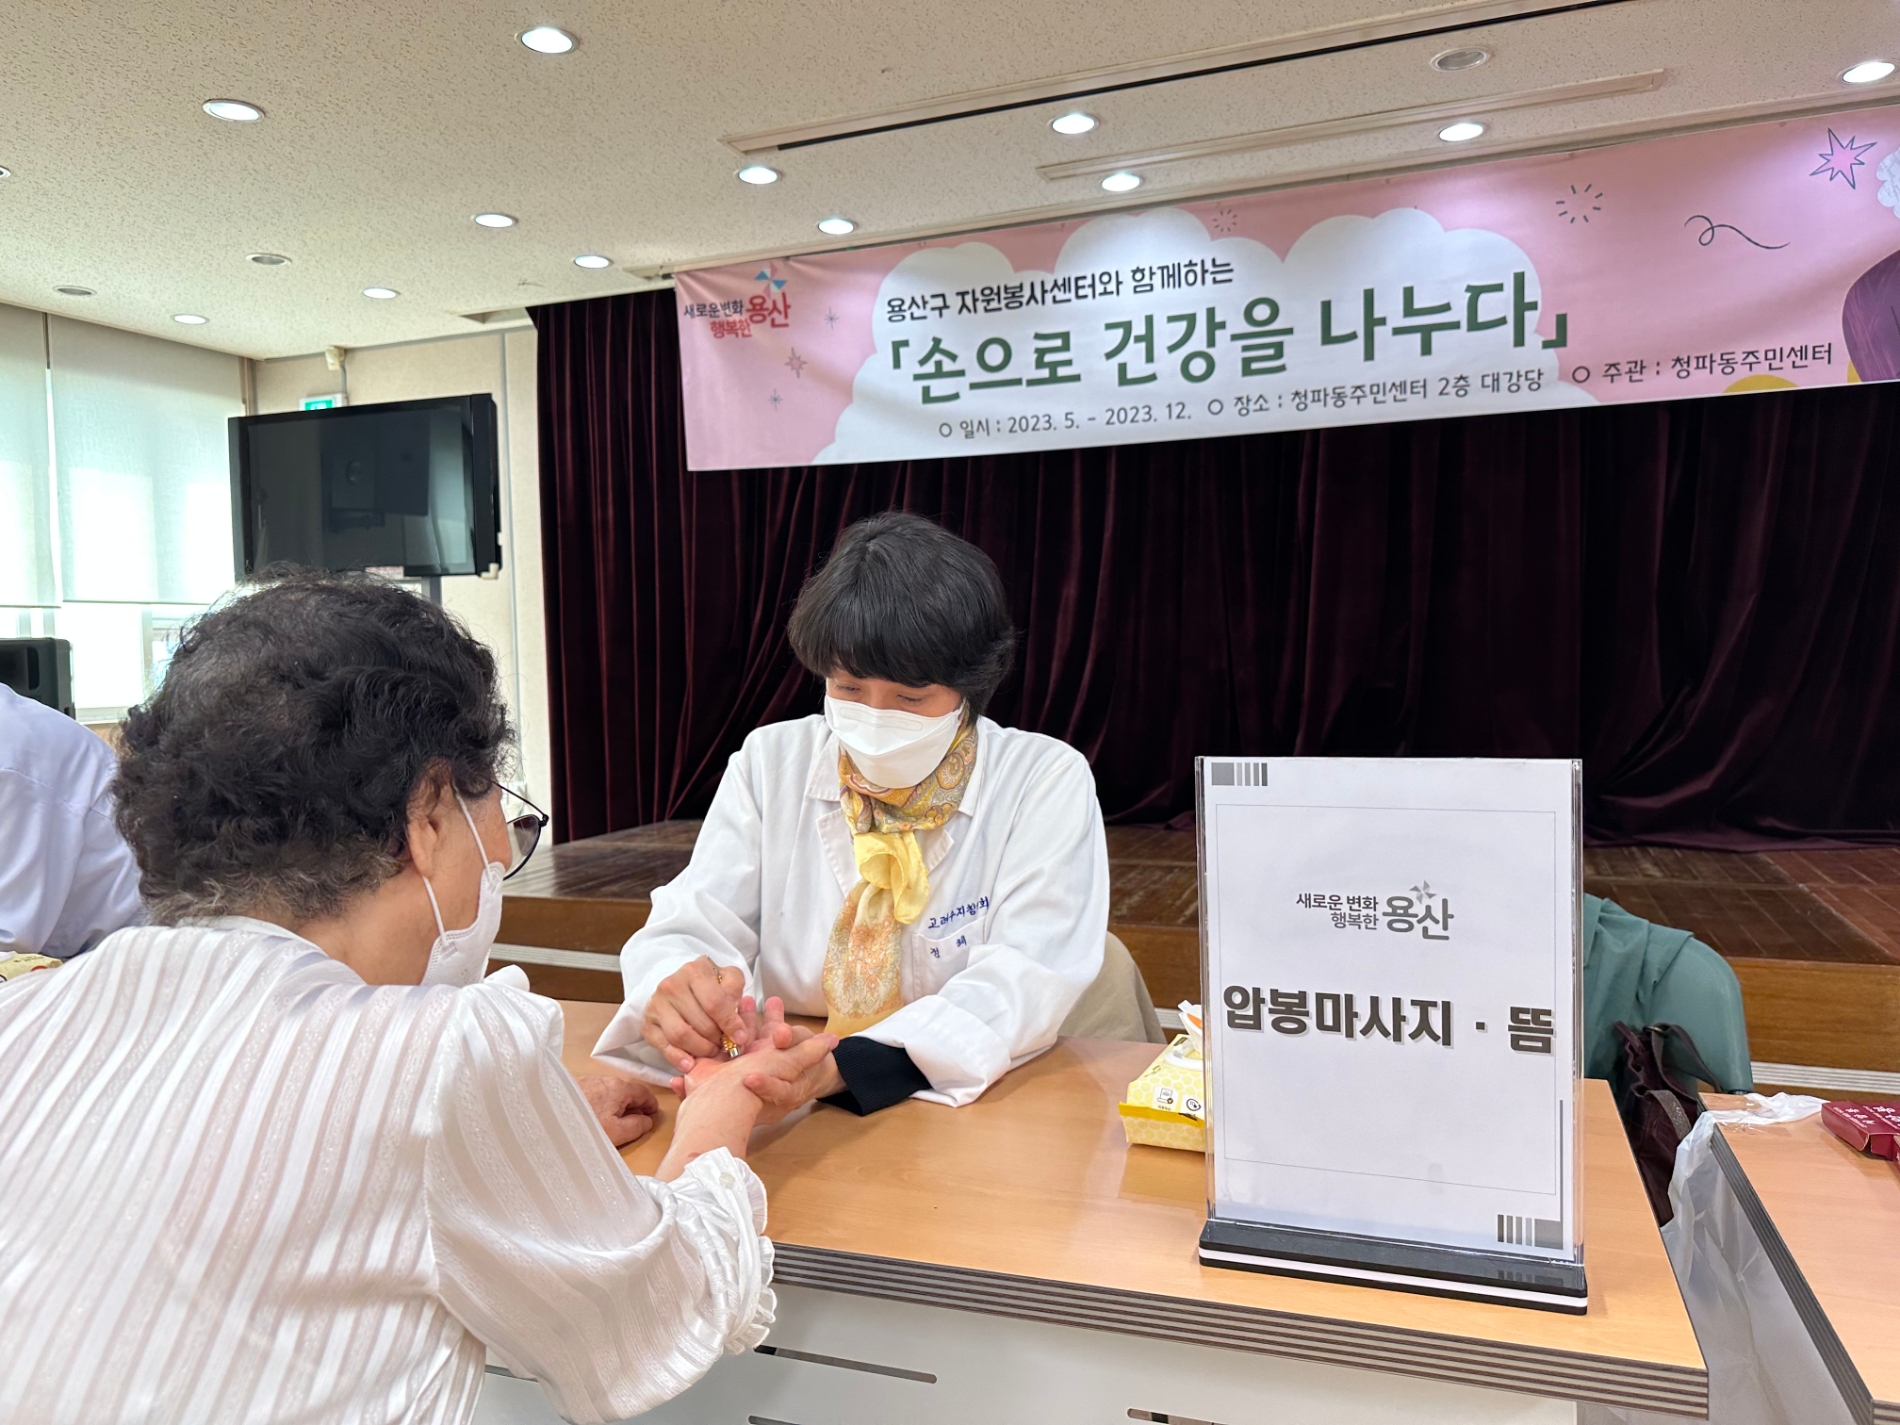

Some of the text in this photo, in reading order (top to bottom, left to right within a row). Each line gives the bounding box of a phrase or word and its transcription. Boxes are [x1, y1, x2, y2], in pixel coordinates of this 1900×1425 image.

[746, 292, 791, 329] 용산
[887, 258, 1234, 323] 용산구 자원봉사센터와 함께하는
[709, 319, 752, 339] 행복한
[1103, 297, 1294, 387] 건강을
[1008, 413, 1058, 434] 2023.
[1064, 411, 1080, 430] 5.
[1105, 405, 1158, 426] 2023.
[1166, 402, 1191, 420] 12.
[1290, 378, 1427, 410] 청파동주민센터
[1438, 374, 1470, 398] 2층
[1481, 369, 1544, 394] 대강당
[1670, 343, 1832, 380] 청파동주민센터
[1296, 892, 1379, 912] 새로운 변화
[1330, 912, 1379, 931] 행복한
[1382, 895, 1455, 941] 용산
[1223, 985, 1454, 1048] 압봉마사지
[1507, 1006, 1555, 1055] 뜸
